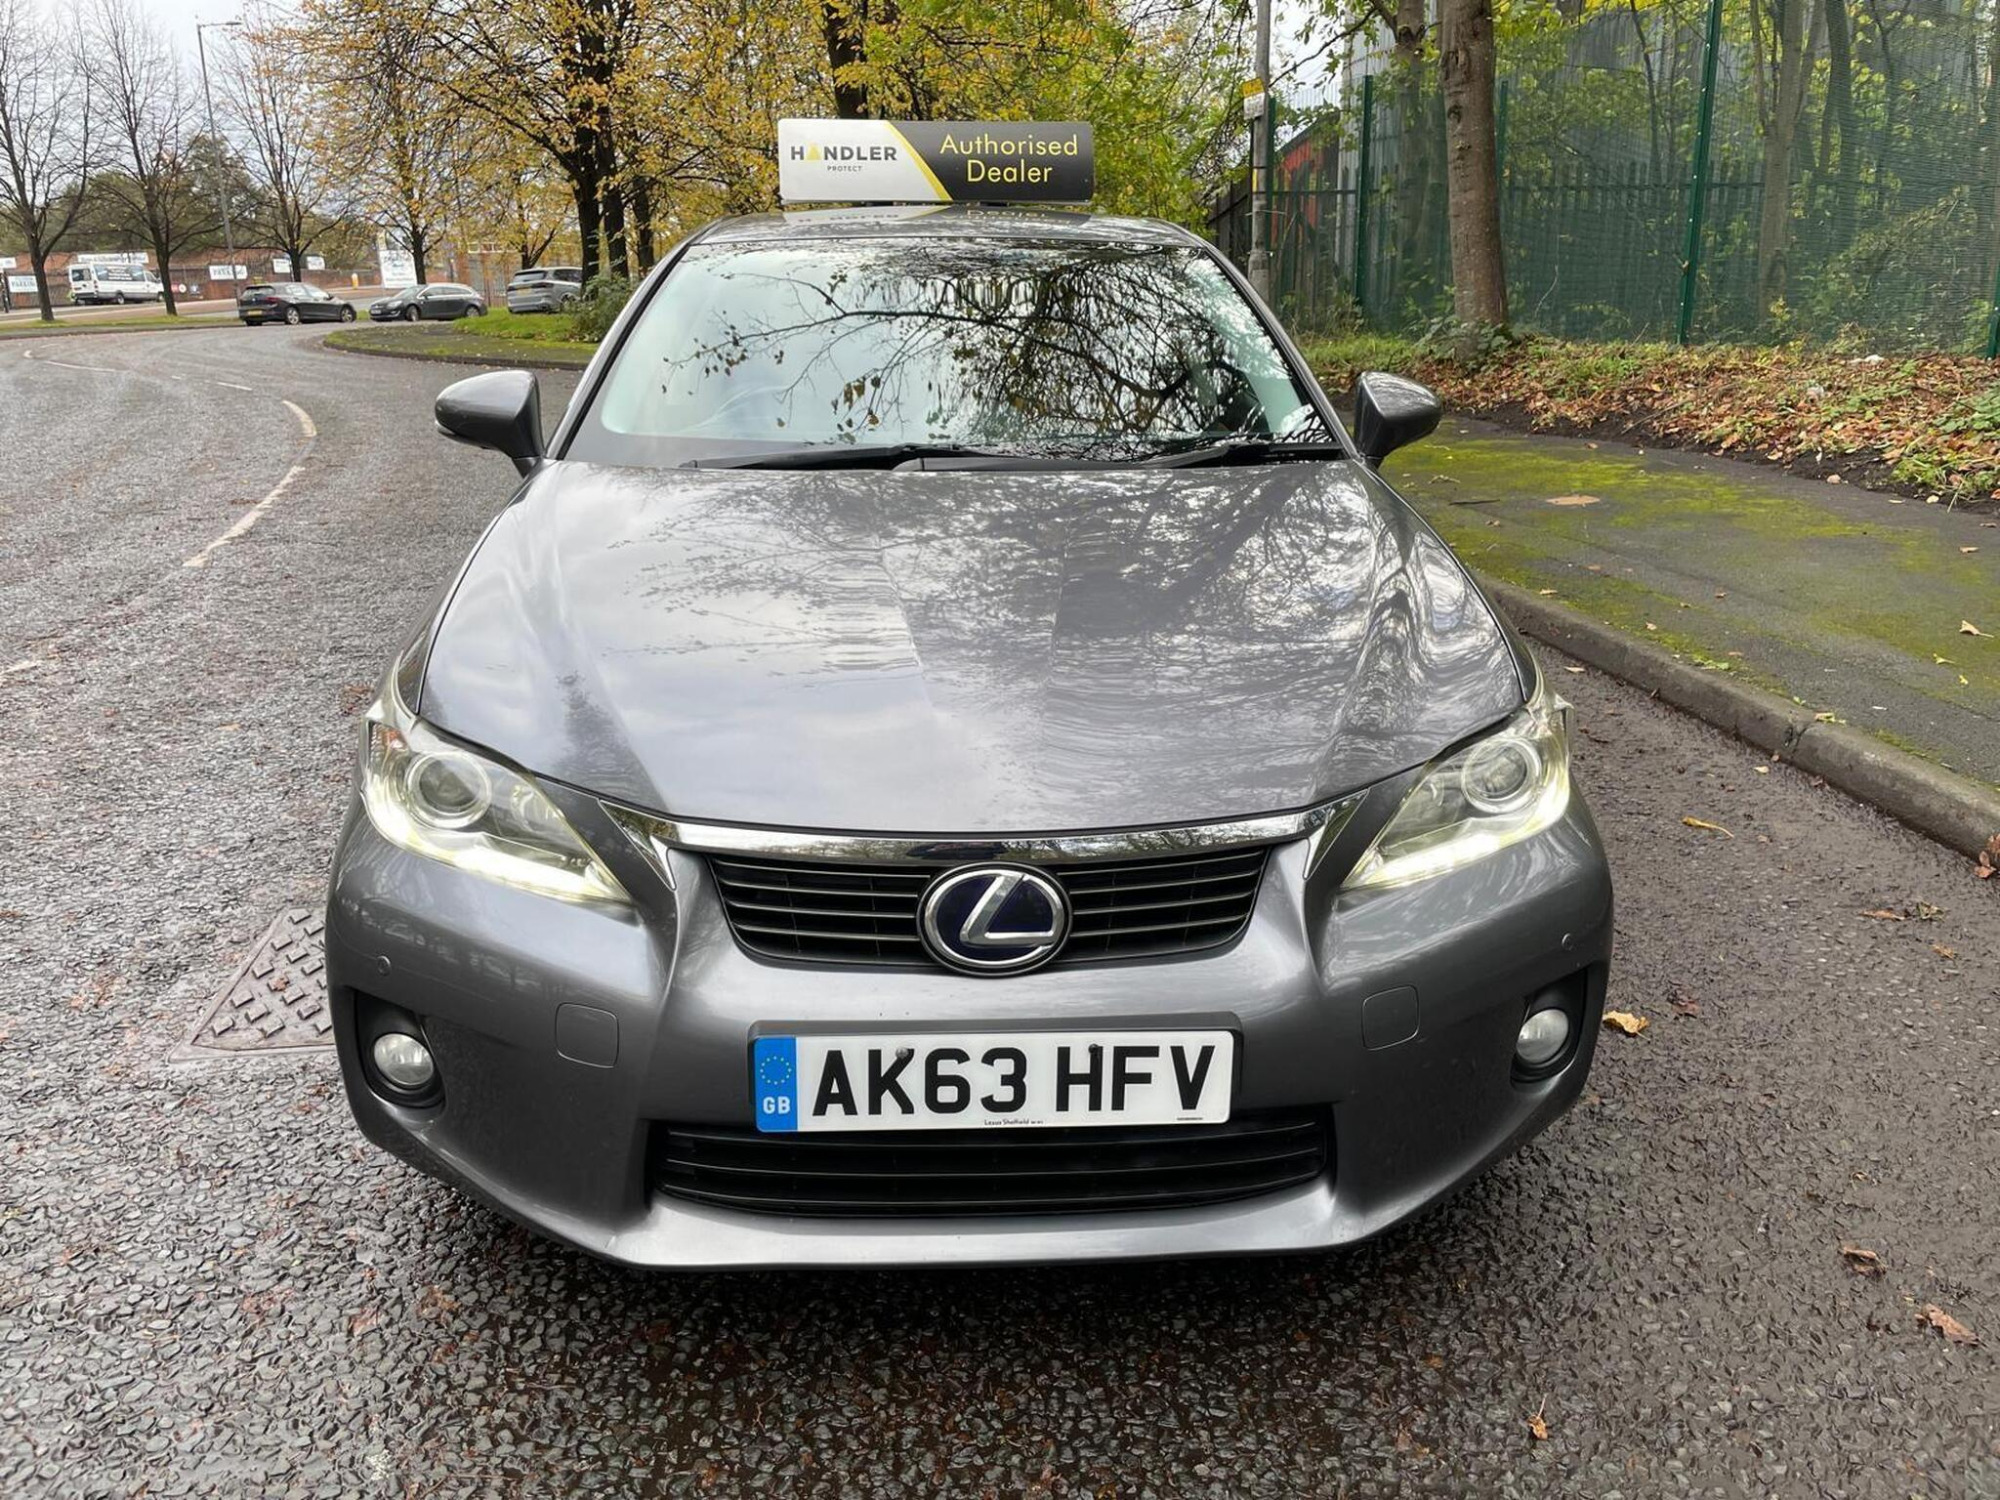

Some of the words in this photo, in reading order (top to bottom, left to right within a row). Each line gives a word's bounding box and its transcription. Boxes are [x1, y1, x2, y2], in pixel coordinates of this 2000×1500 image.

[939, 133, 1079, 156] Authorised
[966, 160, 1053, 184] Dealer
[812, 1047, 1027, 1116] AK63
[1056, 1045, 1216, 1113] HFV
[762, 1096, 791, 1115] GB
